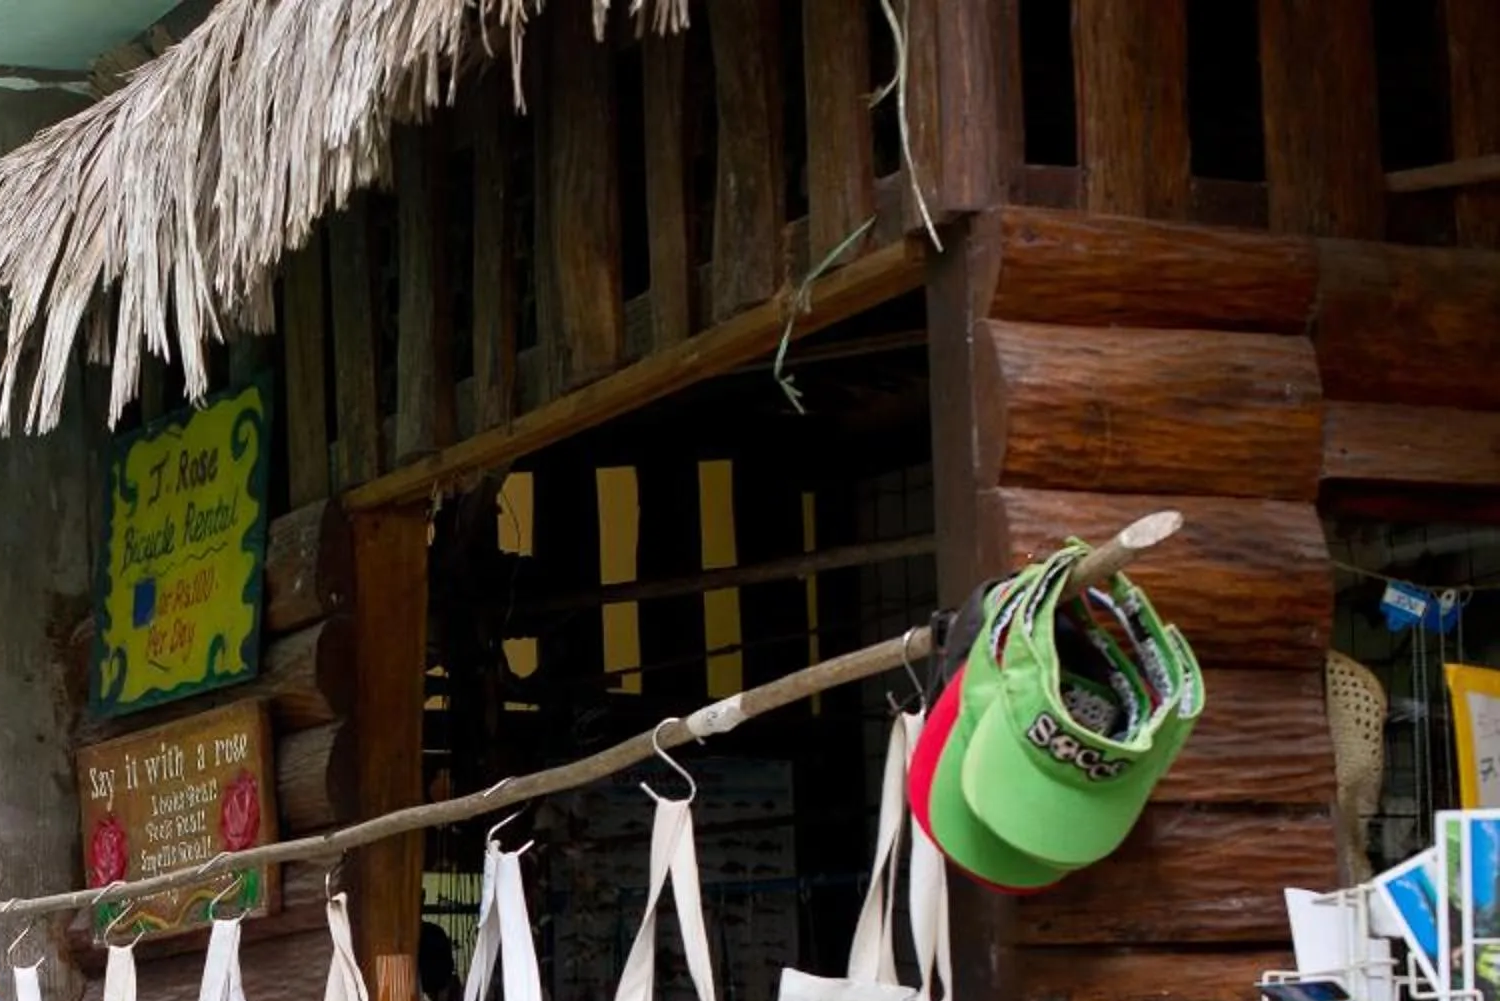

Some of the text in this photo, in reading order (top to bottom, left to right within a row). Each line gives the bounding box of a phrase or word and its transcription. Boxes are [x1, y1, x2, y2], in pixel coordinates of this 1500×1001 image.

[175, 447, 219, 495] Rose
[183, 487, 239, 547] Rental
[89, 732, 248, 812] Say it with a rose
